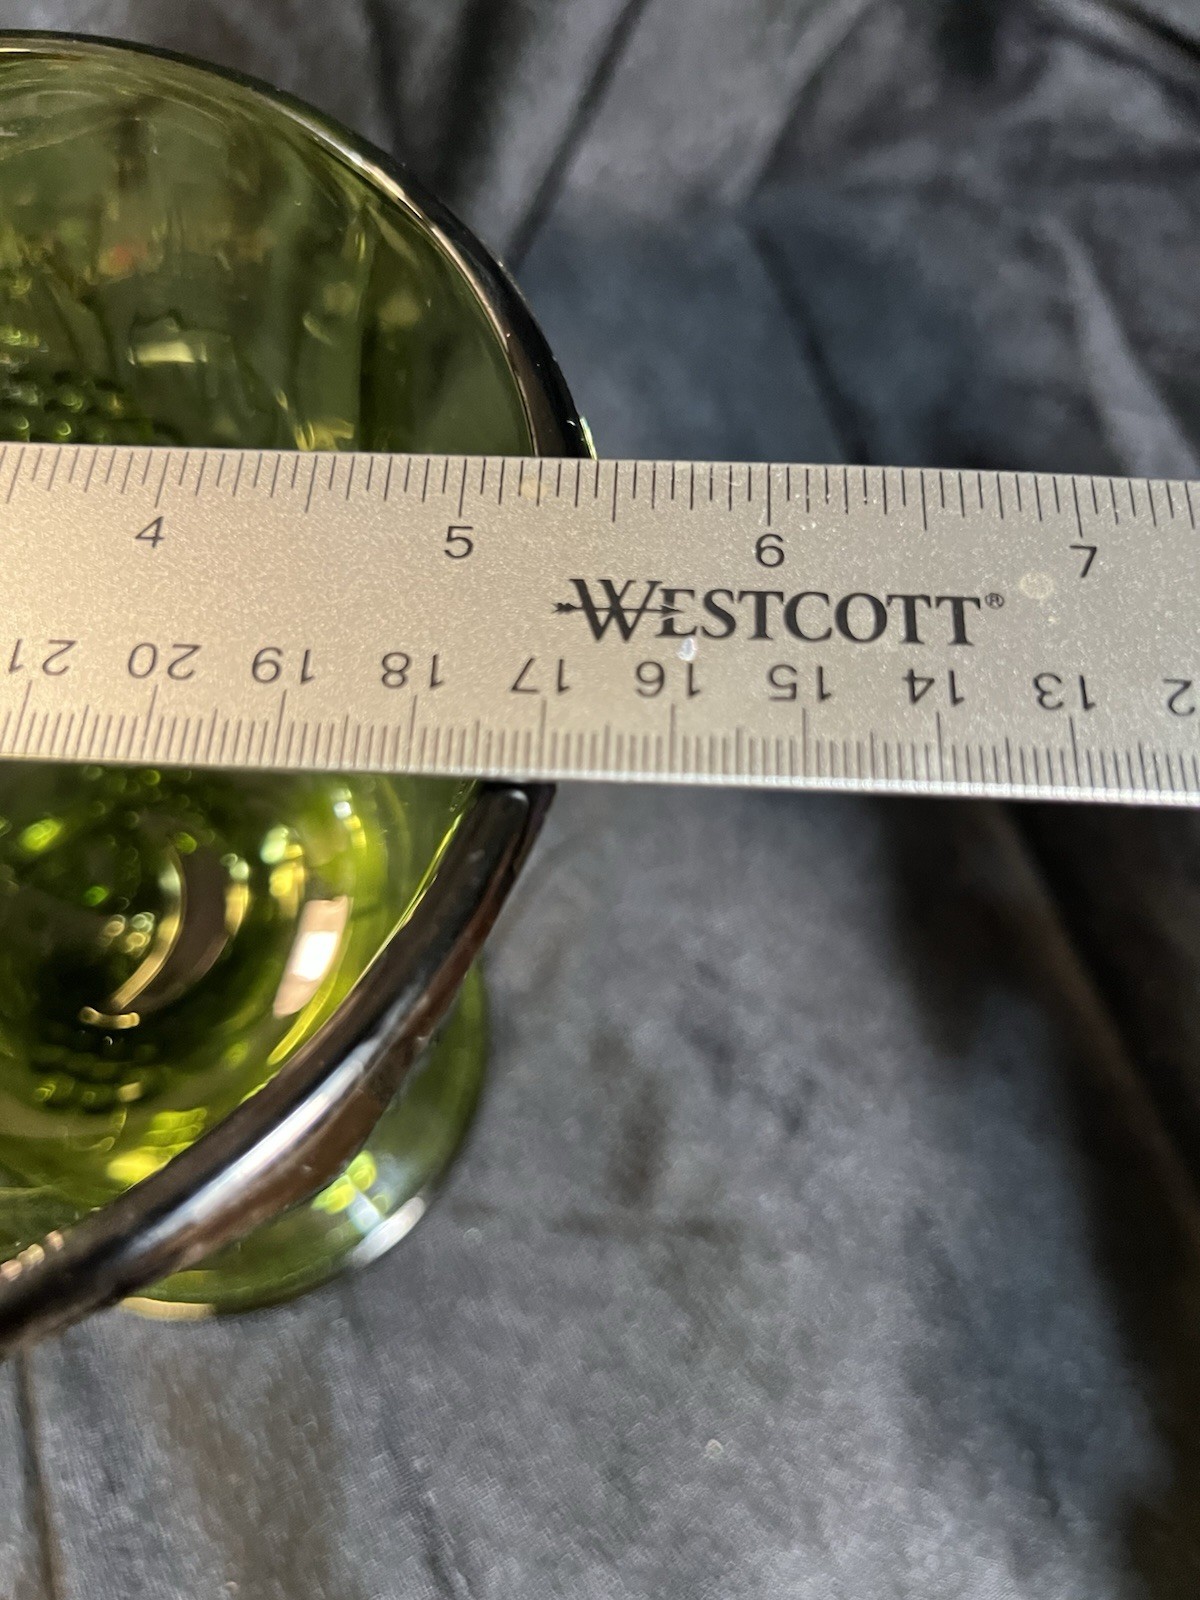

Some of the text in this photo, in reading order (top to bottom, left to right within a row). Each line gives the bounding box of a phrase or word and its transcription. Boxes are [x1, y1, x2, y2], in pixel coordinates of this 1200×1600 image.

[134, 515, 1099, 579] 4 5 6 7
[7, 638, 1198, 718] 2 13 14 15 16 17 18 19 20 21
